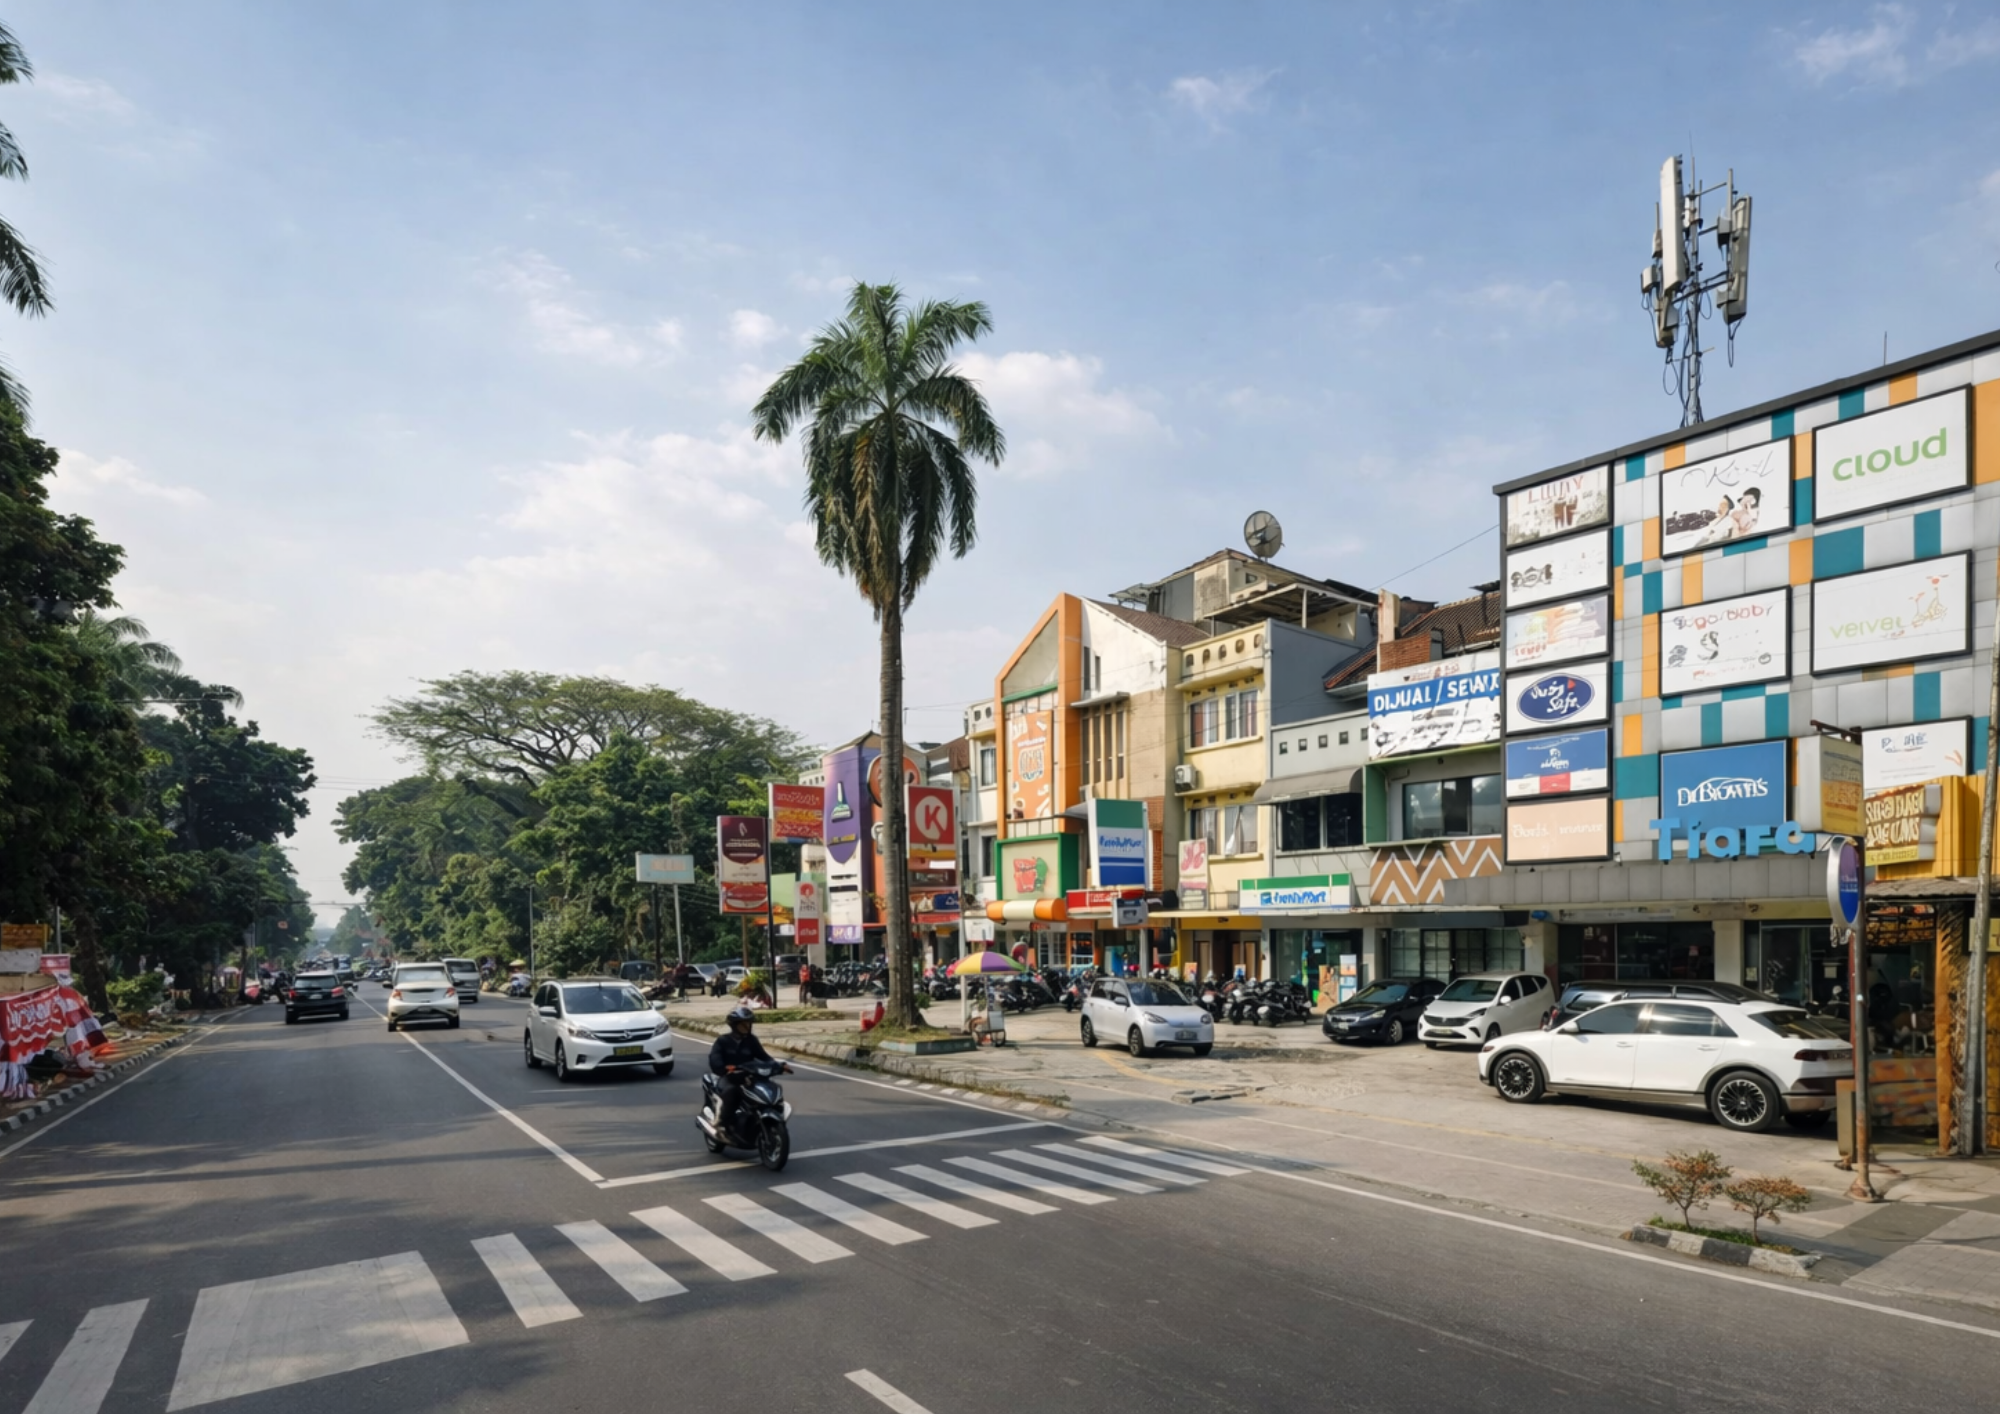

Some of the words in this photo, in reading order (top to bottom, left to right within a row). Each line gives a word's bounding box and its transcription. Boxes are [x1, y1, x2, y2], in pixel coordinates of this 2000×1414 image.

[1832, 427, 1947, 481] cloud
[1374, 686, 1432, 712] DIJUAL
[923, 804, 944, 831] K
